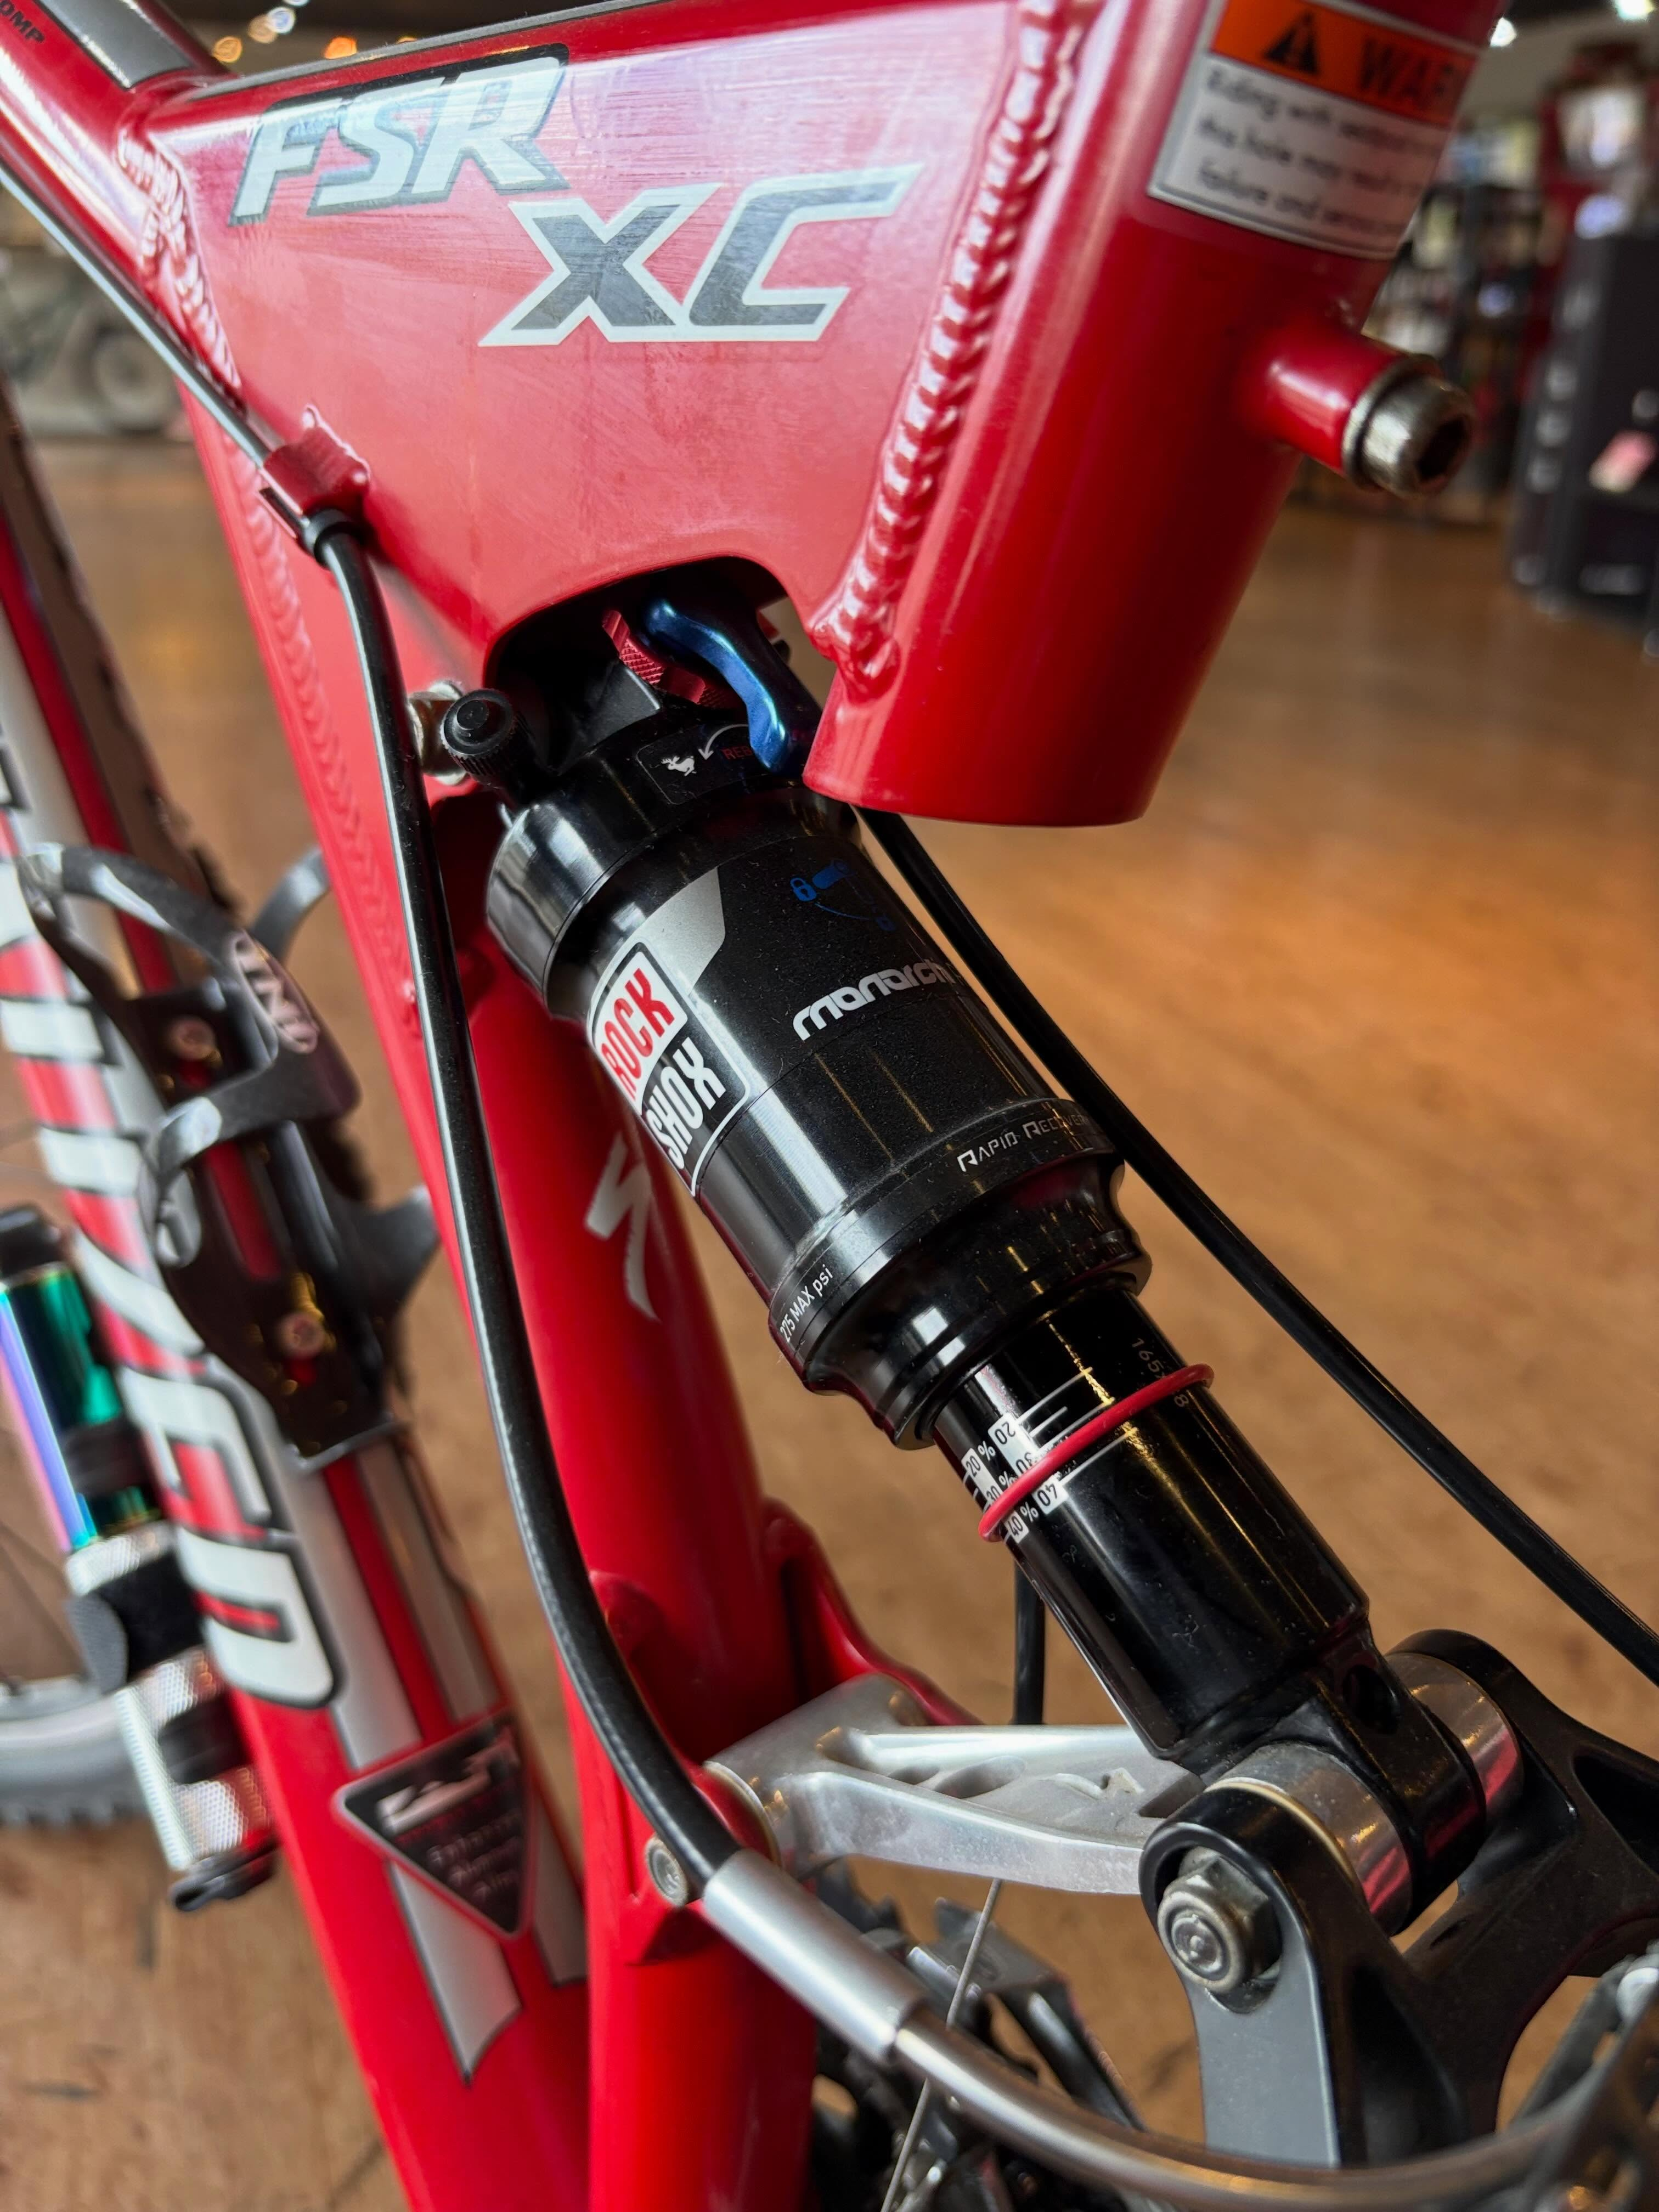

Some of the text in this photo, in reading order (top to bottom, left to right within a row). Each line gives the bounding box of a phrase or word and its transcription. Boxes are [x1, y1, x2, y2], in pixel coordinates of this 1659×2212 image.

[228, 43, 571, 227] FSR
[478, 162, 925, 346] XC
[601, 968, 675, 1102] ROCK
[793, 959, 956, 1041] monarch
[646, 1037, 726, 1169] SHOX
[780, 1263, 833, 1343] 275 MAX psi
